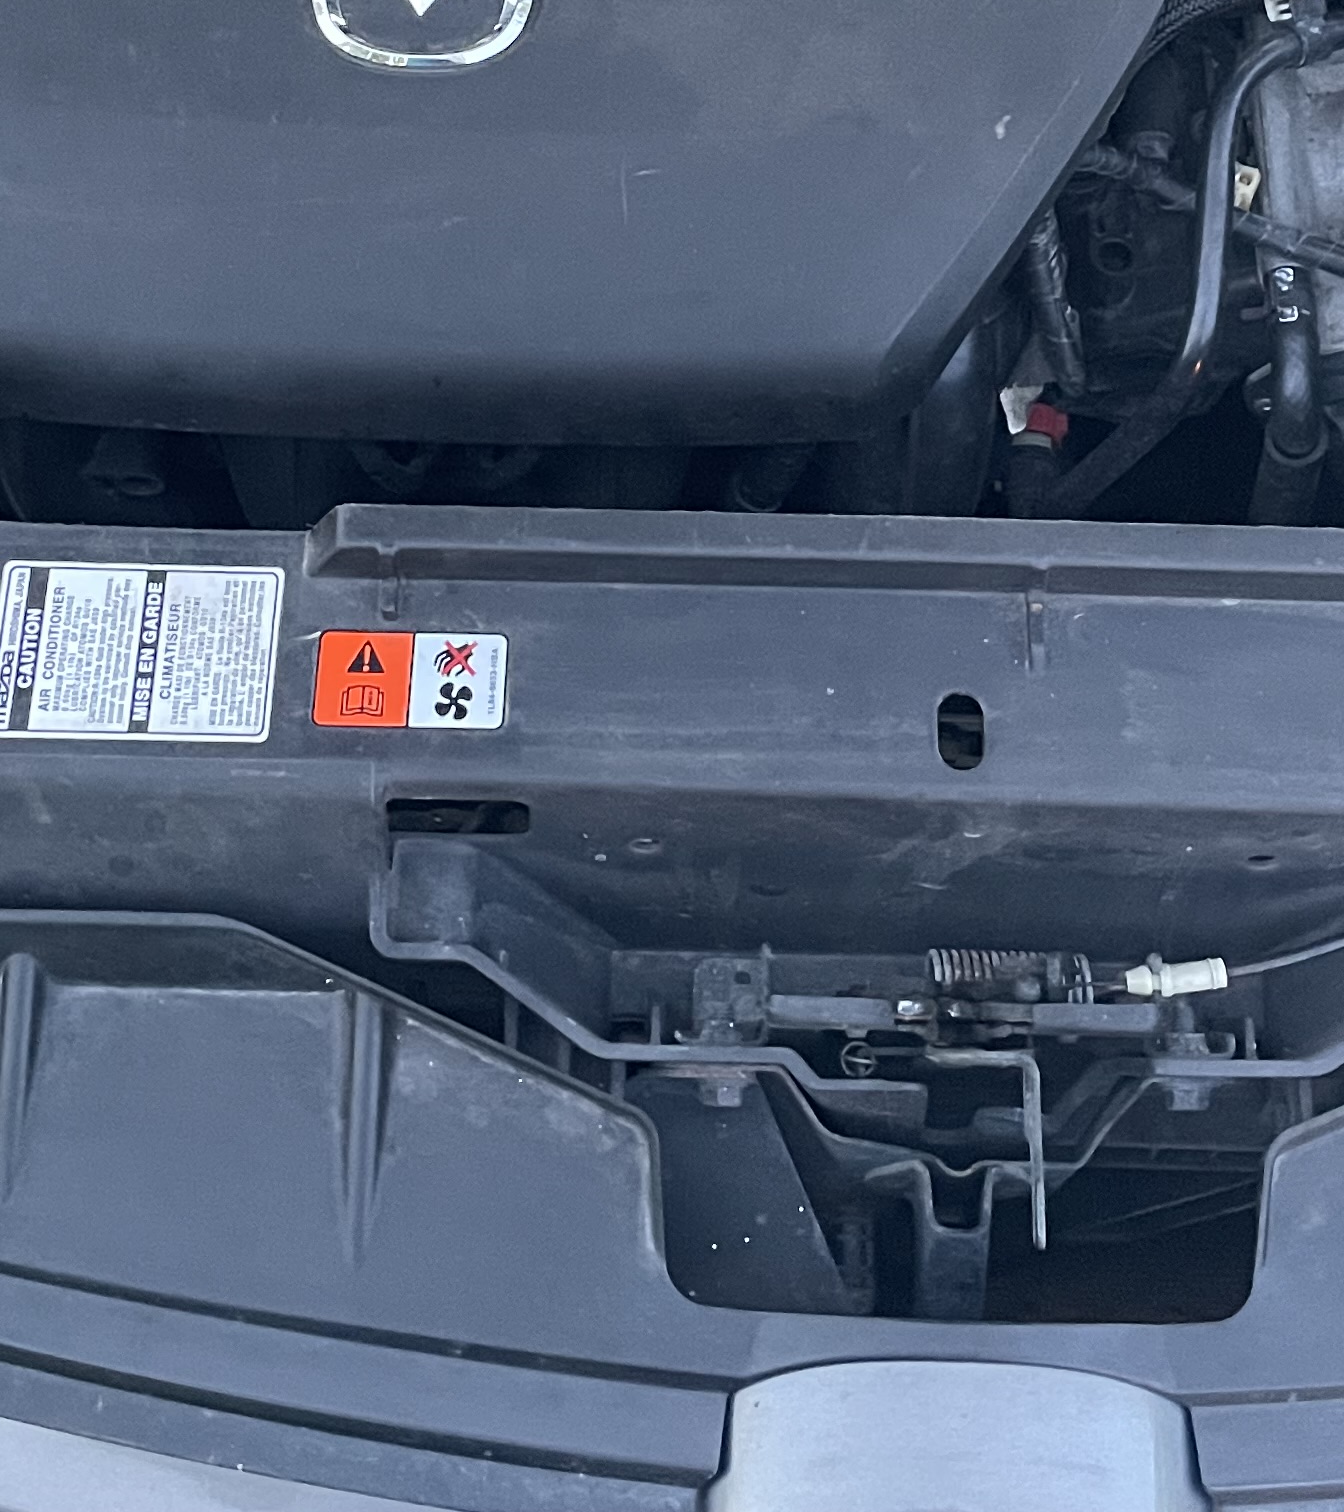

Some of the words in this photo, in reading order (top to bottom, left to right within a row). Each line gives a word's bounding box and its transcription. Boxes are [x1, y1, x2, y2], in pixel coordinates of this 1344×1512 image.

[41, 585, 66, 679] CONDITIONER
[140, 581, 163, 644] GARDE
[15, 607, 42, 689] CAUTION
[137, 647, 155, 673] EN
[158, 602, 181, 699] CLIMATISEUR
[37, 688, 52, 711] AIR
[131, 676, 152, 721] MISE
